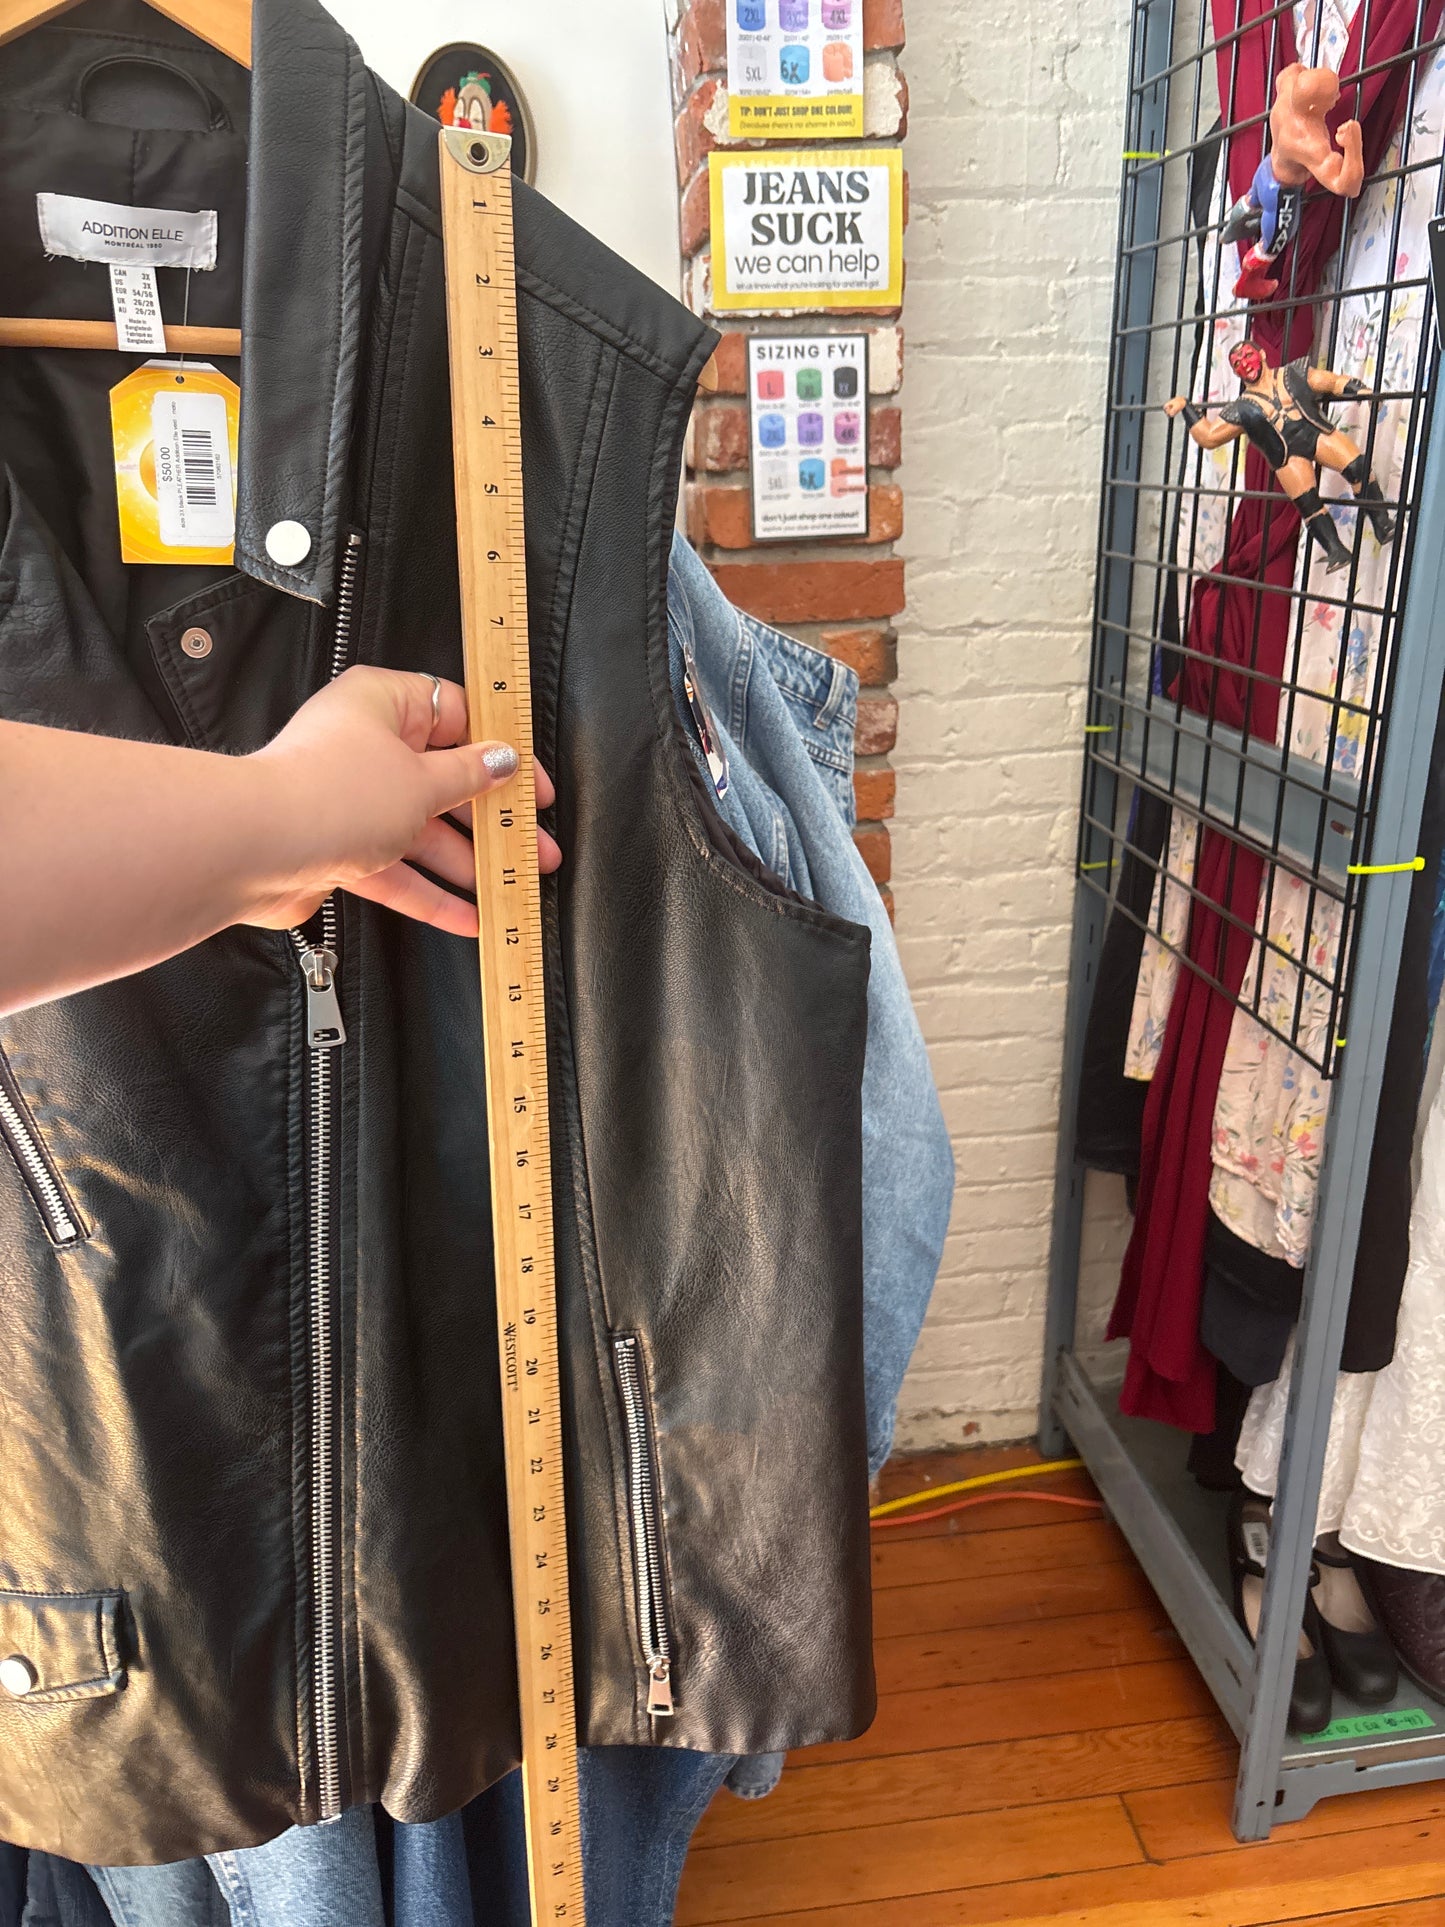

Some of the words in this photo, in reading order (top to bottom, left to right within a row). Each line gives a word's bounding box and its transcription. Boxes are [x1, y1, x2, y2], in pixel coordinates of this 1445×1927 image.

[744, 8, 760, 23] 2XL
[746, 66, 762, 82] 5XL
[780, 59, 801, 83] 6X
[740, 106, 752, 117] TIP:
[754, 106, 772, 117] DON'T
[774, 106, 790, 116] JUST
[792, 106, 808, 116] SHOP
[811, 106, 823, 115] ONE
[743, 170, 870, 205] JEANS
[472, 200, 487, 208] 1
[82, 220, 148, 240] ADDITION
[152, 228, 184, 242] ELLE
[751, 211, 864, 246] SUCK
[735, 255, 772, 274] we
[776, 253, 823, 274] can
[829, 248, 880, 280] help
[476, 273, 490, 285] 2
[478, 345, 494, 356] 3
[757, 345, 820, 360] SIZING
[828, 344, 855, 358] FYI
[482, 416, 496, 426] 4
[160, 447, 173, 482] $50.00
[484, 483, 498, 494] 5
[800, 469, 818, 491] 6X
[486, 550, 502, 561] 6
[490, 616, 504, 626] 7
[493, 681, 508, 692] 8
[500, 807, 514, 828] 10
[502, 867, 516, 886] 11
[506, 926, 520, 946] 12
[508, 983, 522, 1002] 13
[510, 1040, 524, 1058] 14
[513, 1095, 527, 1114] 15
[516, 1148, 529, 1168] 16
[518, 1202, 532, 1221] 17
[520, 1255, 534, 1274] 18
[524, 1307, 536, 1326] 19
[525, 1358, 538, 1376] 20
[528, 1408, 540, 1425] 21
[530, 1457, 543, 1475] 22
[533, 1504, 545, 1522] 23
[536, 1552, 548, 1568] 24
[538, 1598, 550, 1615] 25
[540, 1643, 553, 1660] 26
[542, 1688, 555, 1705] 27
[545, 1732, 557, 1750] 28
[548, 1776, 560, 1793] 29
[550, 1820, 562, 1836] 30
[552, 1861, 564, 1876] 31
[554, 1902, 567, 1918] 32
